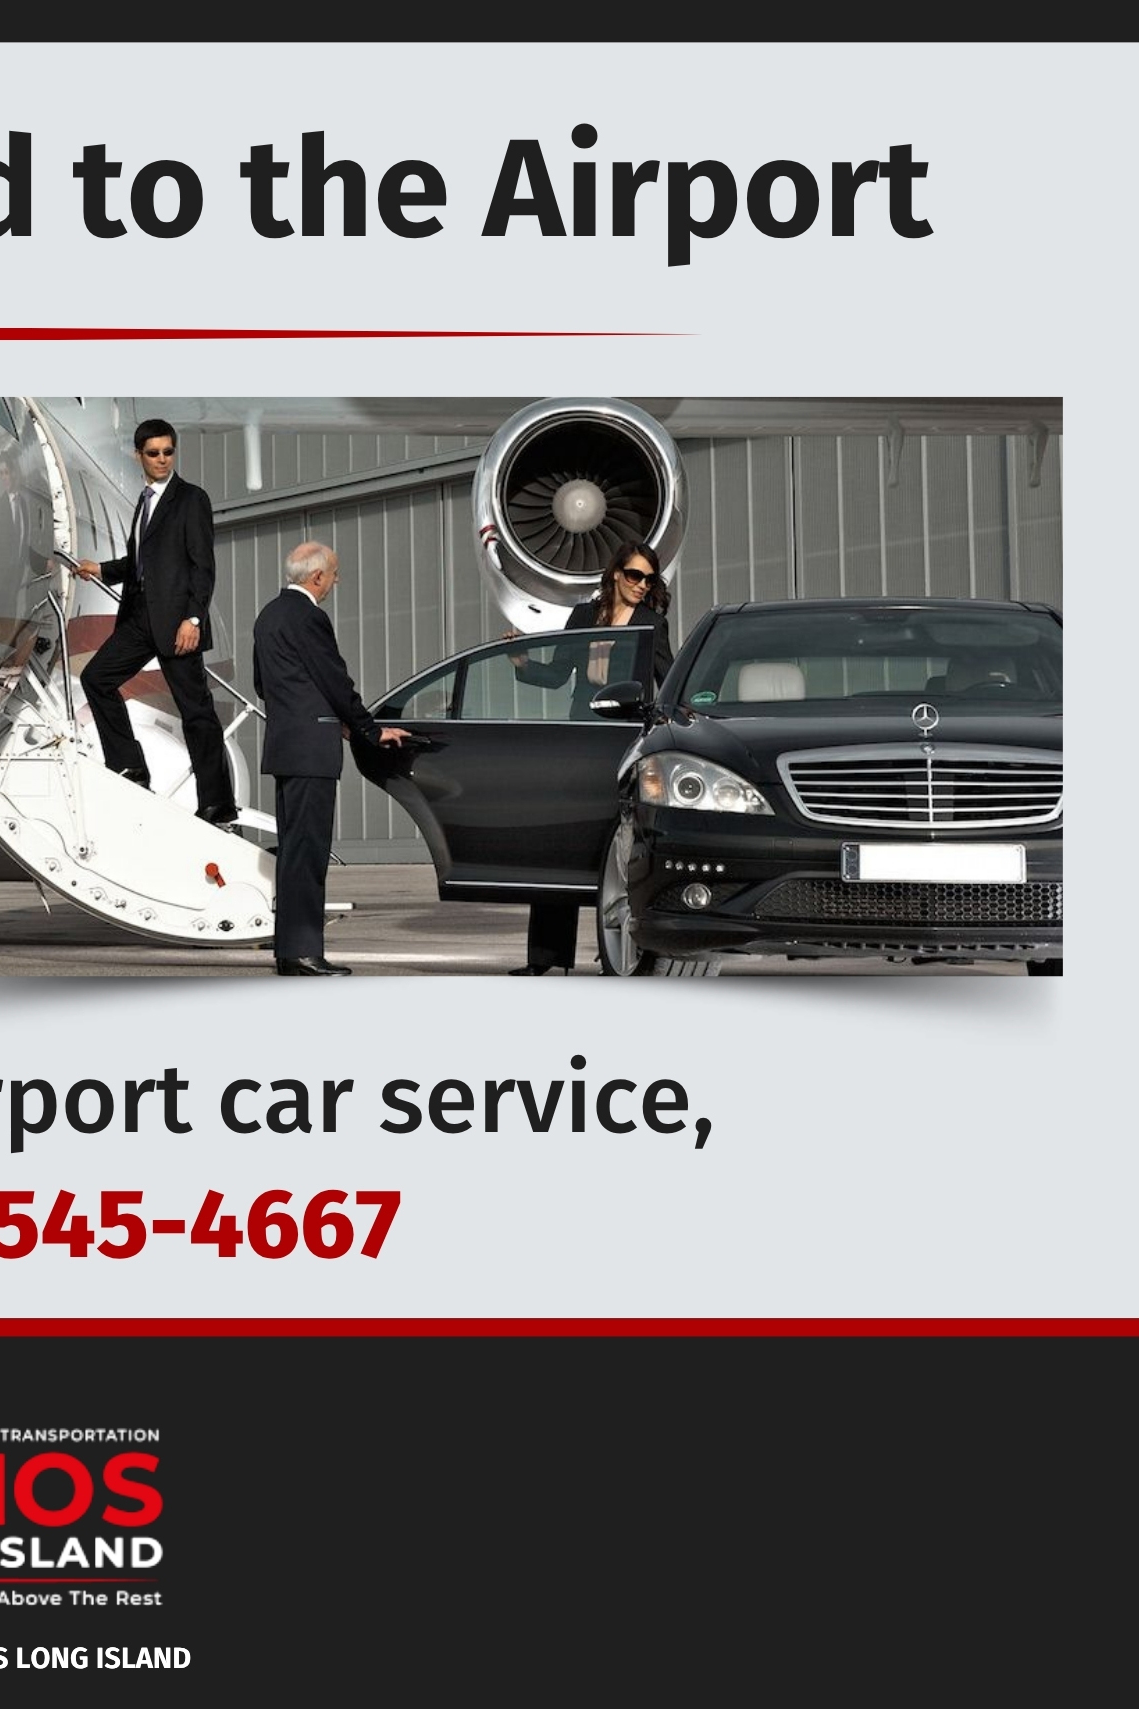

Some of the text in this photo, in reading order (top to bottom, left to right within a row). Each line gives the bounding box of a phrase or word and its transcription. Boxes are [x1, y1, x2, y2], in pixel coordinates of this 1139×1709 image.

[73, 144, 203, 238] to
[240, 131, 447, 238] the
[481, 123, 934, 267] Airport
[221, 1079, 354, 1134] car
[380, 1055, 713, 1149] service,
[0, 1428, 161, 1443] TRANSPORTATION
[68, 1590, 109, 1606] The
[116, 1590, 163, 1606] Rest
[16, 1646, 89, 1670] LONG
[96, 1646, 192, 1670] ISLAND
